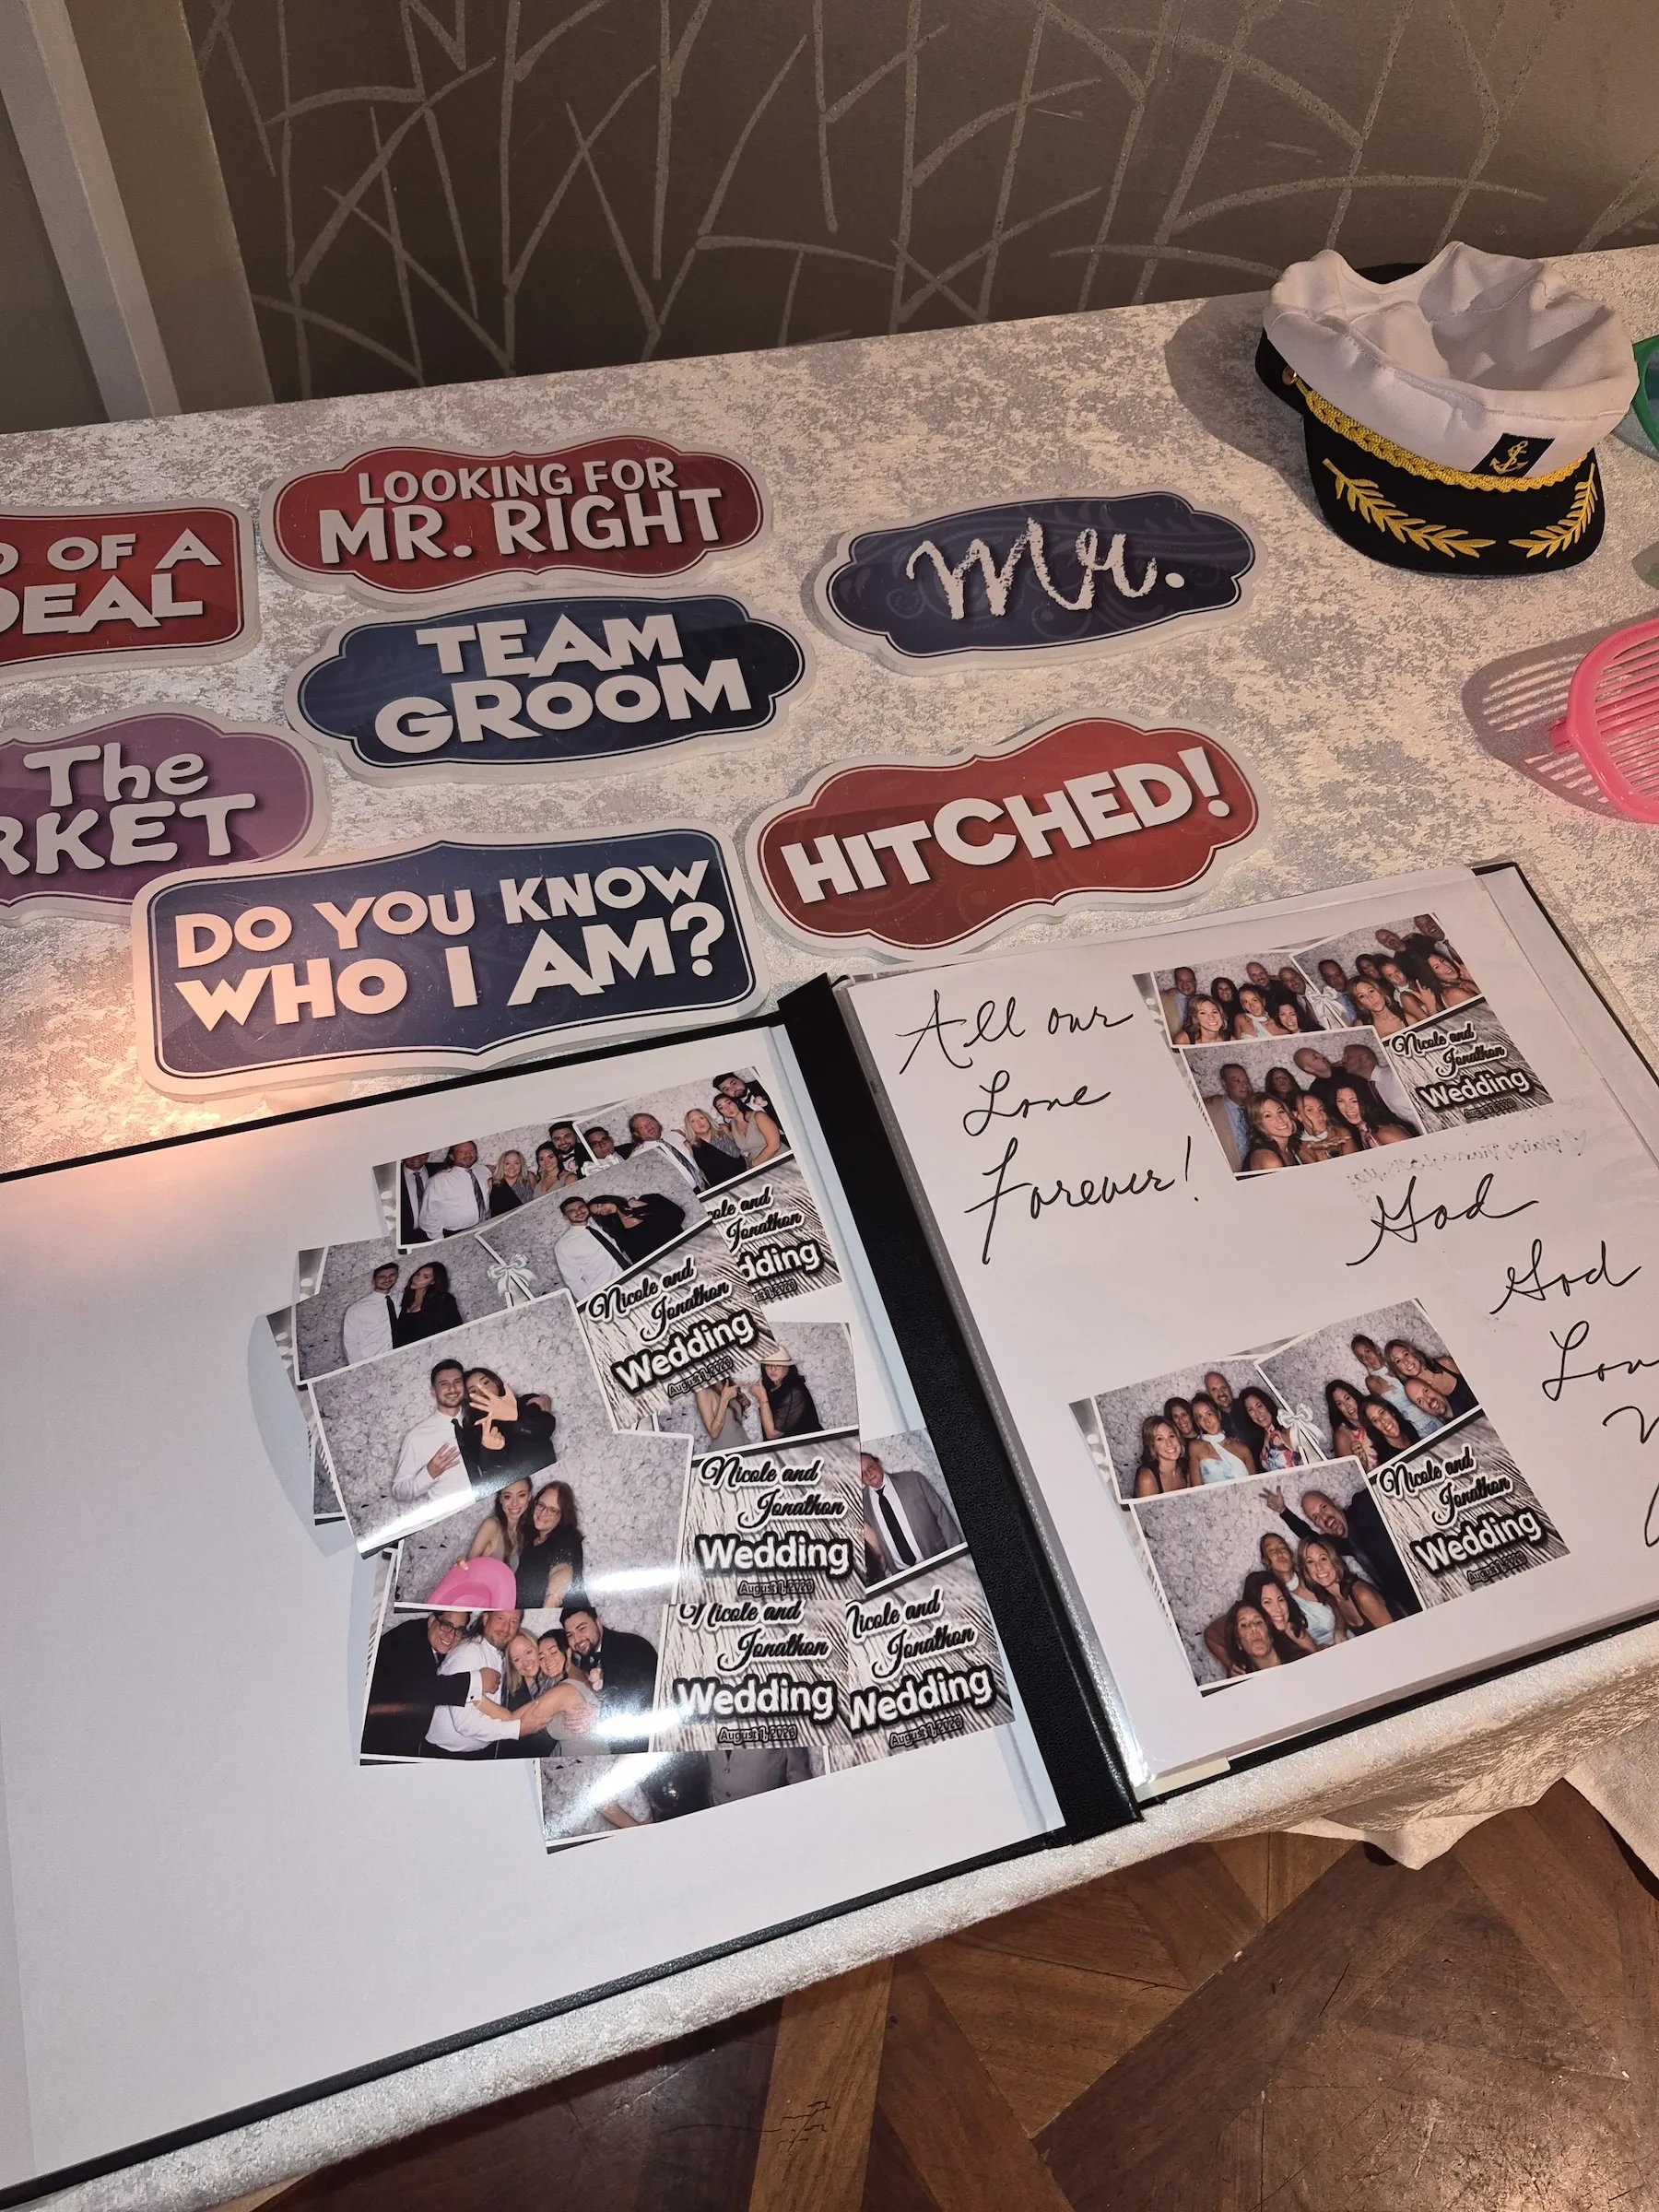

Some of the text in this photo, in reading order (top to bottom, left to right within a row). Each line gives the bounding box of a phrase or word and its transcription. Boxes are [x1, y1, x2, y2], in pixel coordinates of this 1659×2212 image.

[358, 457, 679, 506] LOOKING FOR
[46, 533, 136, 571] OF
[154, 527, 223, 570] A
[318, 488, 723, 564] MR. RIGHT
[905, 516, 1186, 621] Mr.
[415, 613, 685, 678] TEAM
[374, 658, 753, 754] GROOM
[22, 741, 209, 807] The
[779, 746, 1231, 905] HITCHED!
[174, 860, 710, 969] DO YOU KNOW
[174, 900, 726, 1033] WHO I AM?
[895, 989, 1134, 1075] All our
[1449, 1023, 1475, 1043] and
[1419, 1070, 1530, 1108] Wedding
[740, 1186, 771, 1213] and
[963, 1136, 1198, 1265] Forever!
[588, 1257, 694, 1320] Nicole and
[615, 1312, 755, 1392] Wedding
[668, 1371, 701, 1396] August
[700, 1455, 822, 1488] Nicole and
[1379, 1445, 1475, 1496] Nicole and
[699, 1533, 850, 1575] Wedding
[1415, 1512, 1542, 1572] Wedding
[738, 1580, 776, 1596] August
[763, 1600, 803, 1621] and
[905, 1589, 941, 1620] and
[677, 1679, 833, 1720] Wedding
[719, 1727, 759, 1744] August
[889, 1724, 928, 1747] August
